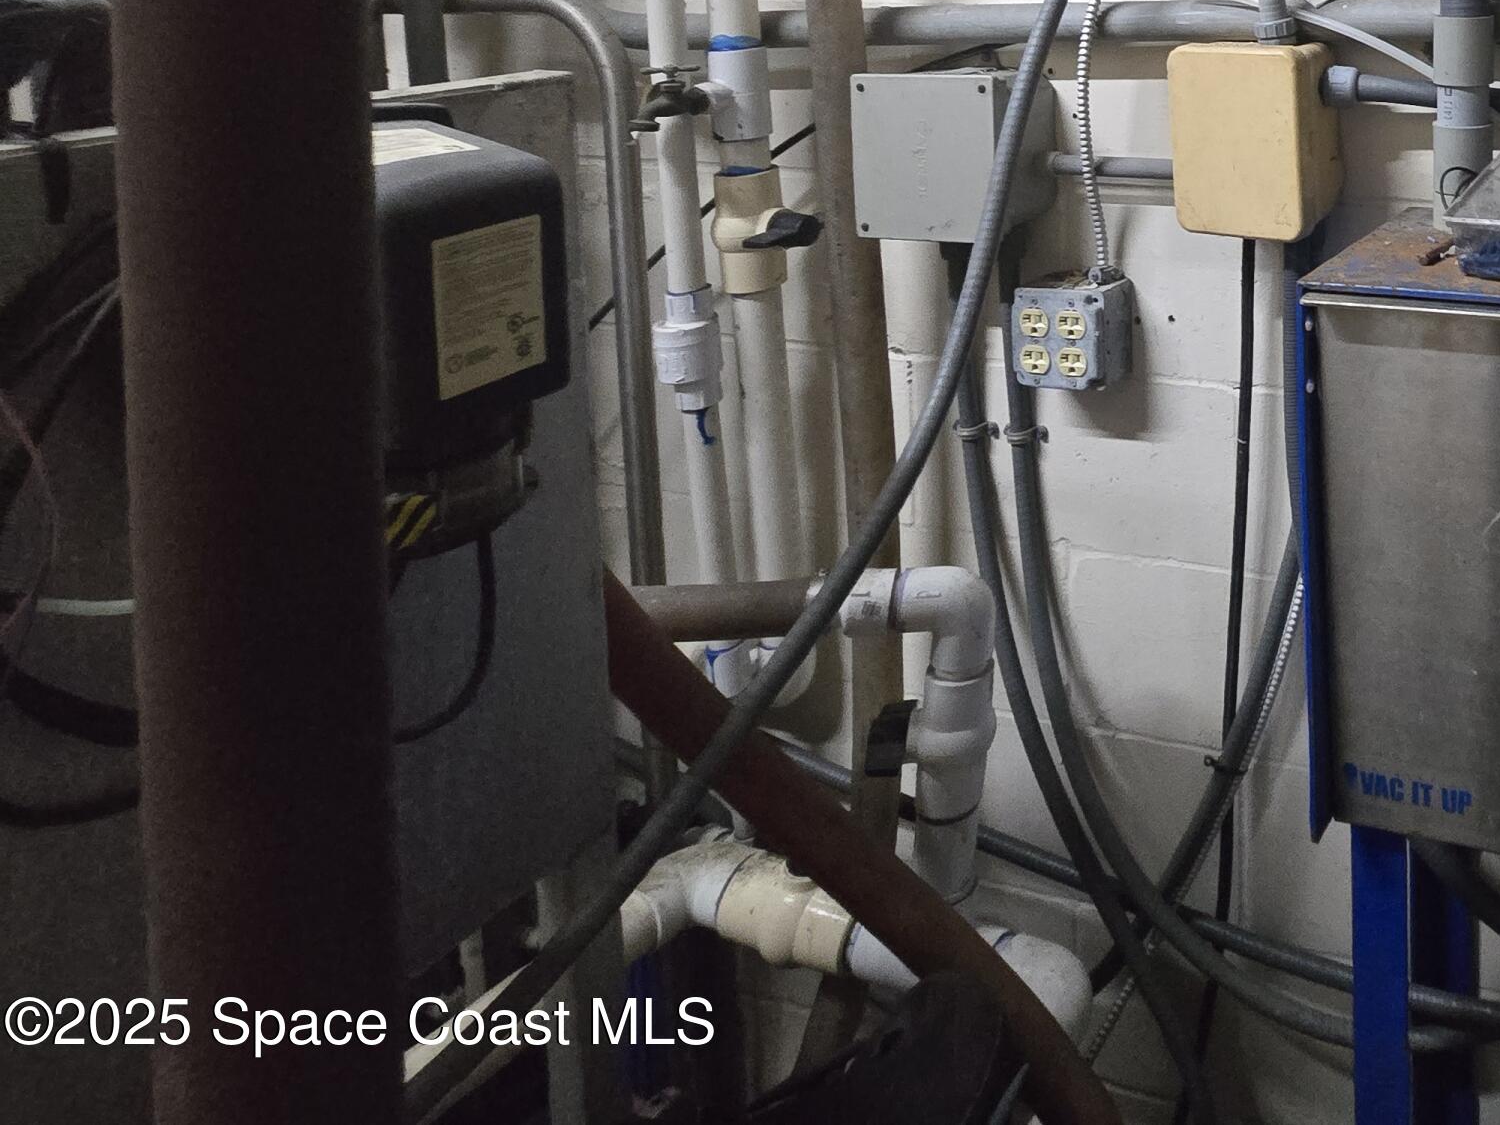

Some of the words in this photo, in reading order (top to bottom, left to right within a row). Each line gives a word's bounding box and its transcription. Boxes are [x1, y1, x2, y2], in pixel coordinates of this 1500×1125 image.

[1360, 770, 1404, 803] VAC
[1411, 780, 1434, 808] IT
[1441, 787, 1473, 815] UP
